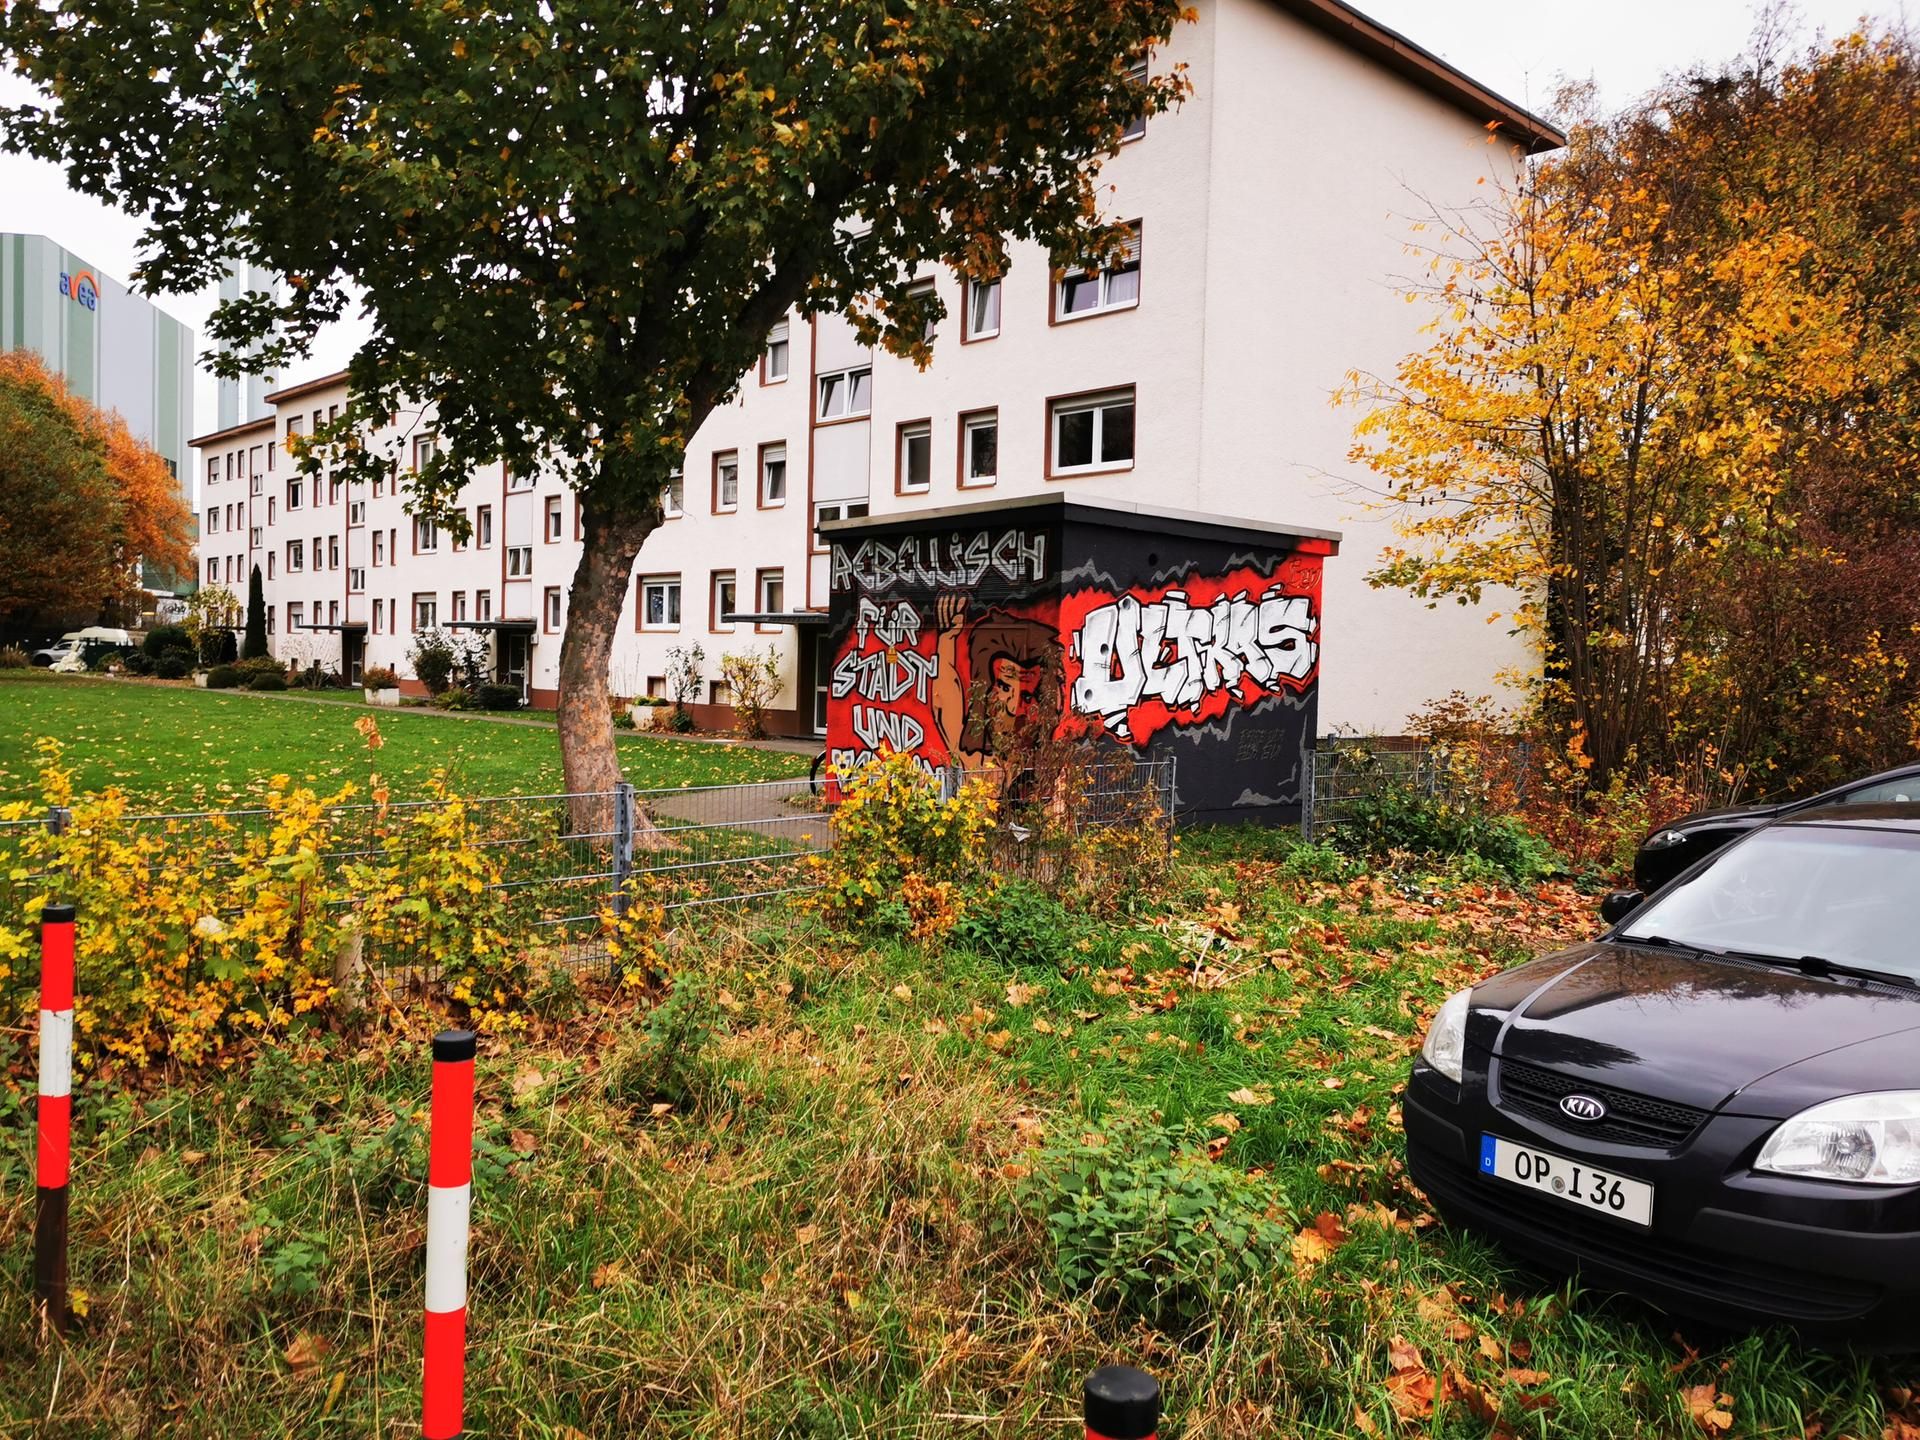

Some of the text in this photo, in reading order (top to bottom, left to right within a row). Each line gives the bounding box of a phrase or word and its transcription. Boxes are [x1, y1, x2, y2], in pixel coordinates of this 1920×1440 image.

[60, 269, 99, 311] avea
[857, 597, 921, 649] FÜR
[1070, 586, 1317, 716] ULTRAS
[832, 650, 938, 704] STADT
[853, 705, 924, 753] UND
[1566, 1098, 1596, 1117] KIA
[1484, 1156, 1492, 1167] D
[1515, 1151, 1551, 1183] OP
